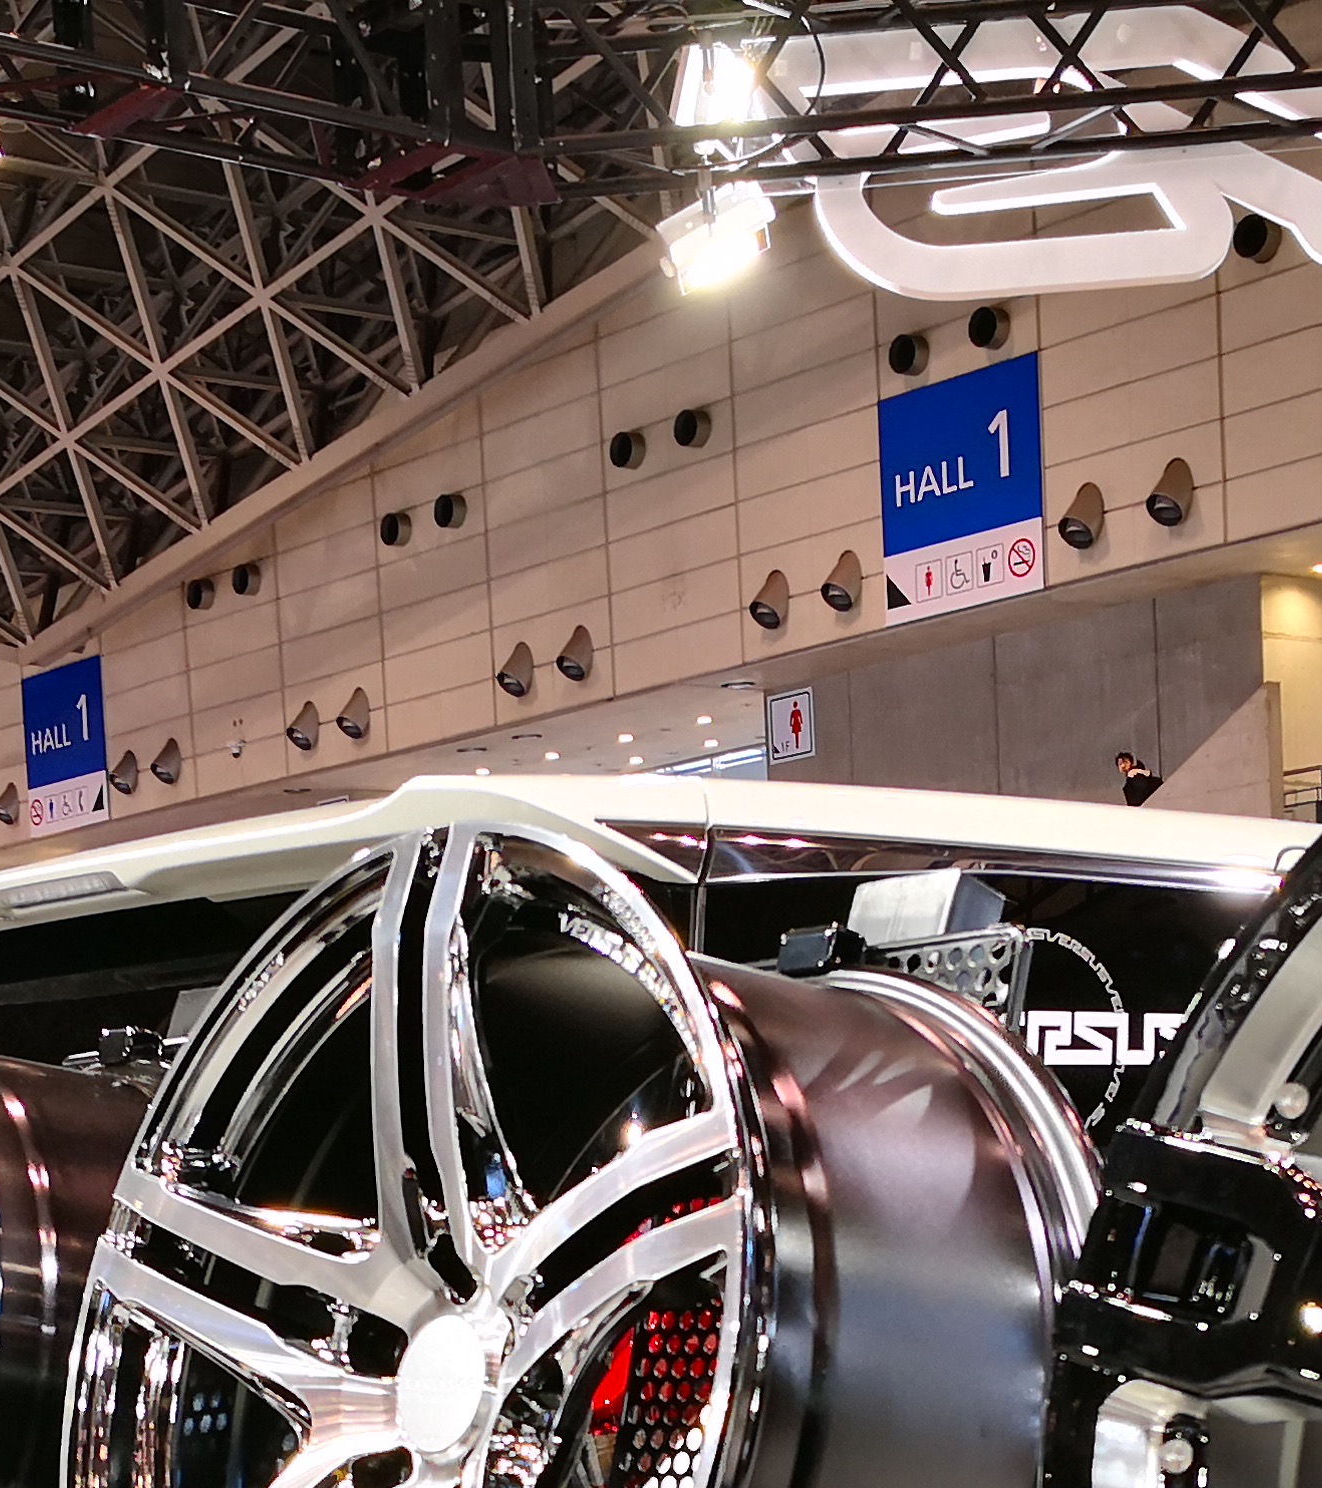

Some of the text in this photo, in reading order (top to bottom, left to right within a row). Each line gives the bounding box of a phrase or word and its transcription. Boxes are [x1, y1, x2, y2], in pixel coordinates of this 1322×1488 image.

[894, 408, 1010, 508] HALL 1
[30, 693, 90, 756] HALL 1
